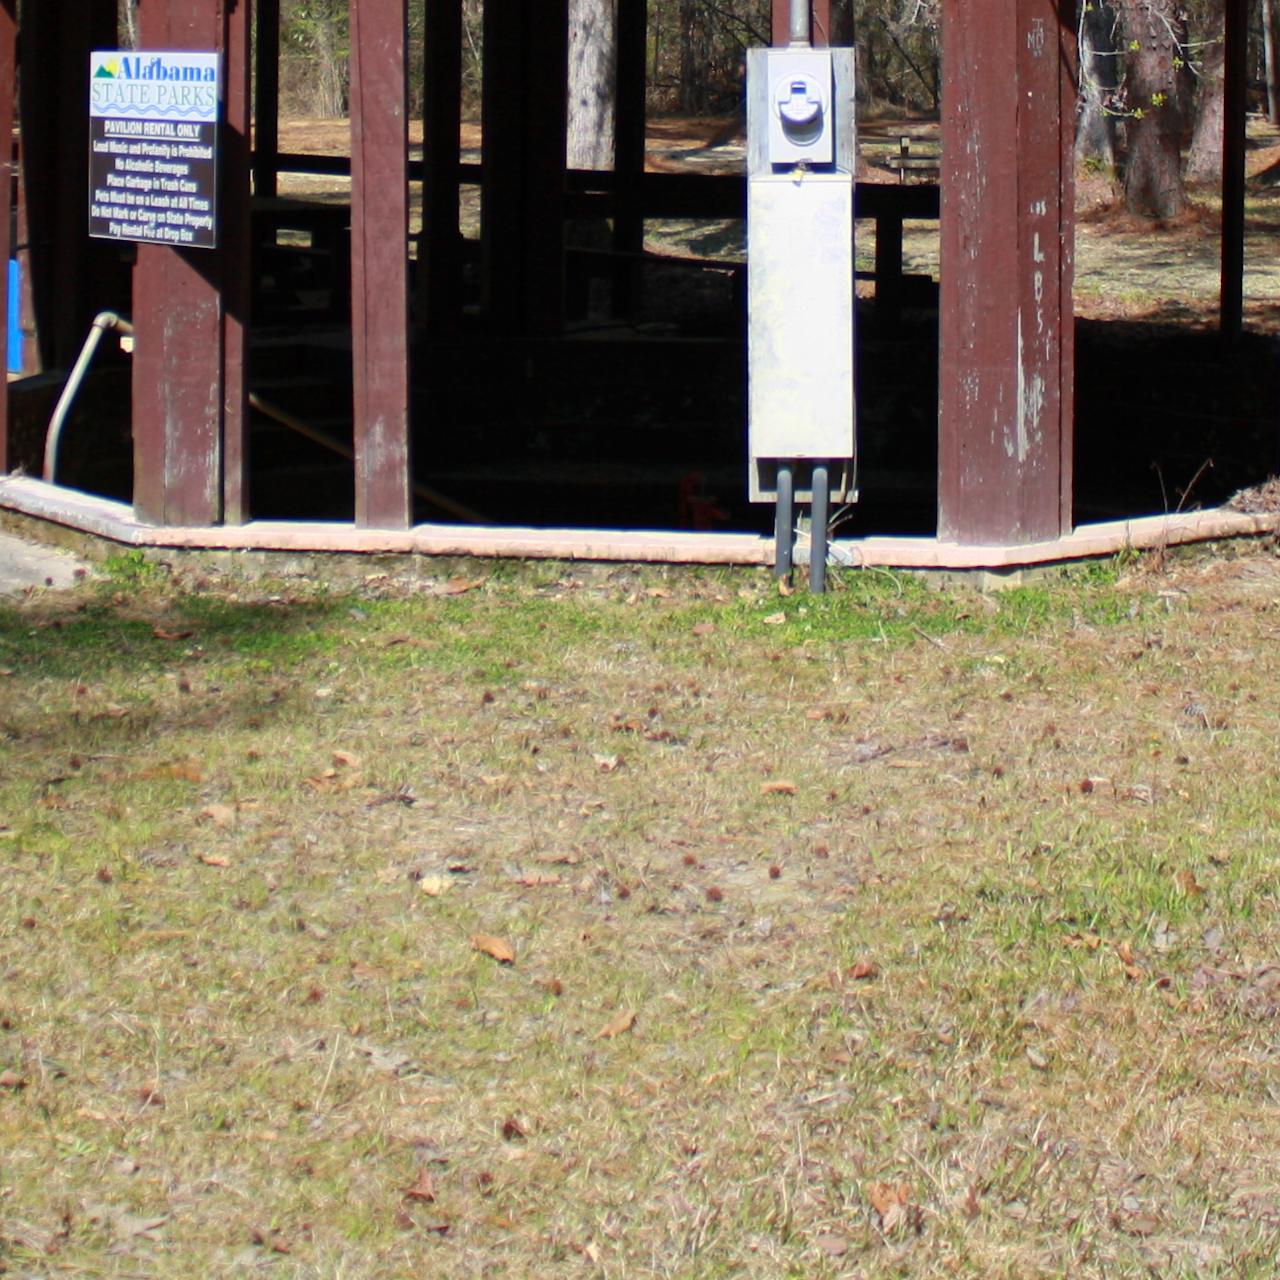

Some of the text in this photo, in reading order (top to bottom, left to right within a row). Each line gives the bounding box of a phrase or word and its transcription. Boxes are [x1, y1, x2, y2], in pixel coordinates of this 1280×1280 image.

[118, 57, 214, 81] Alabama
[92, 83, 215, 106] STATE PARKS
[104, 120, 200, 137] PAVILION RENTAL ONLY
[94, 140, 212, 159] Loud Music and Profanity is Prohibited
[115, 158, 188, 176] No Alcoholic Beverages
[107, 174, 197, 192] Place Garbage in Trash Cans
[96, 190, 208, 210] Pets Must be on a Leash at All Times
[92, 205, 212, 230] Do Not Mark or Carve on State Property
[109, 222, 120, 236] Pay
[122, 224, 142, 235] Rental
[156, 226, 163, 238] at
[164, 227, 179, 242] Drop
[181, 229, 192, 240] Box
